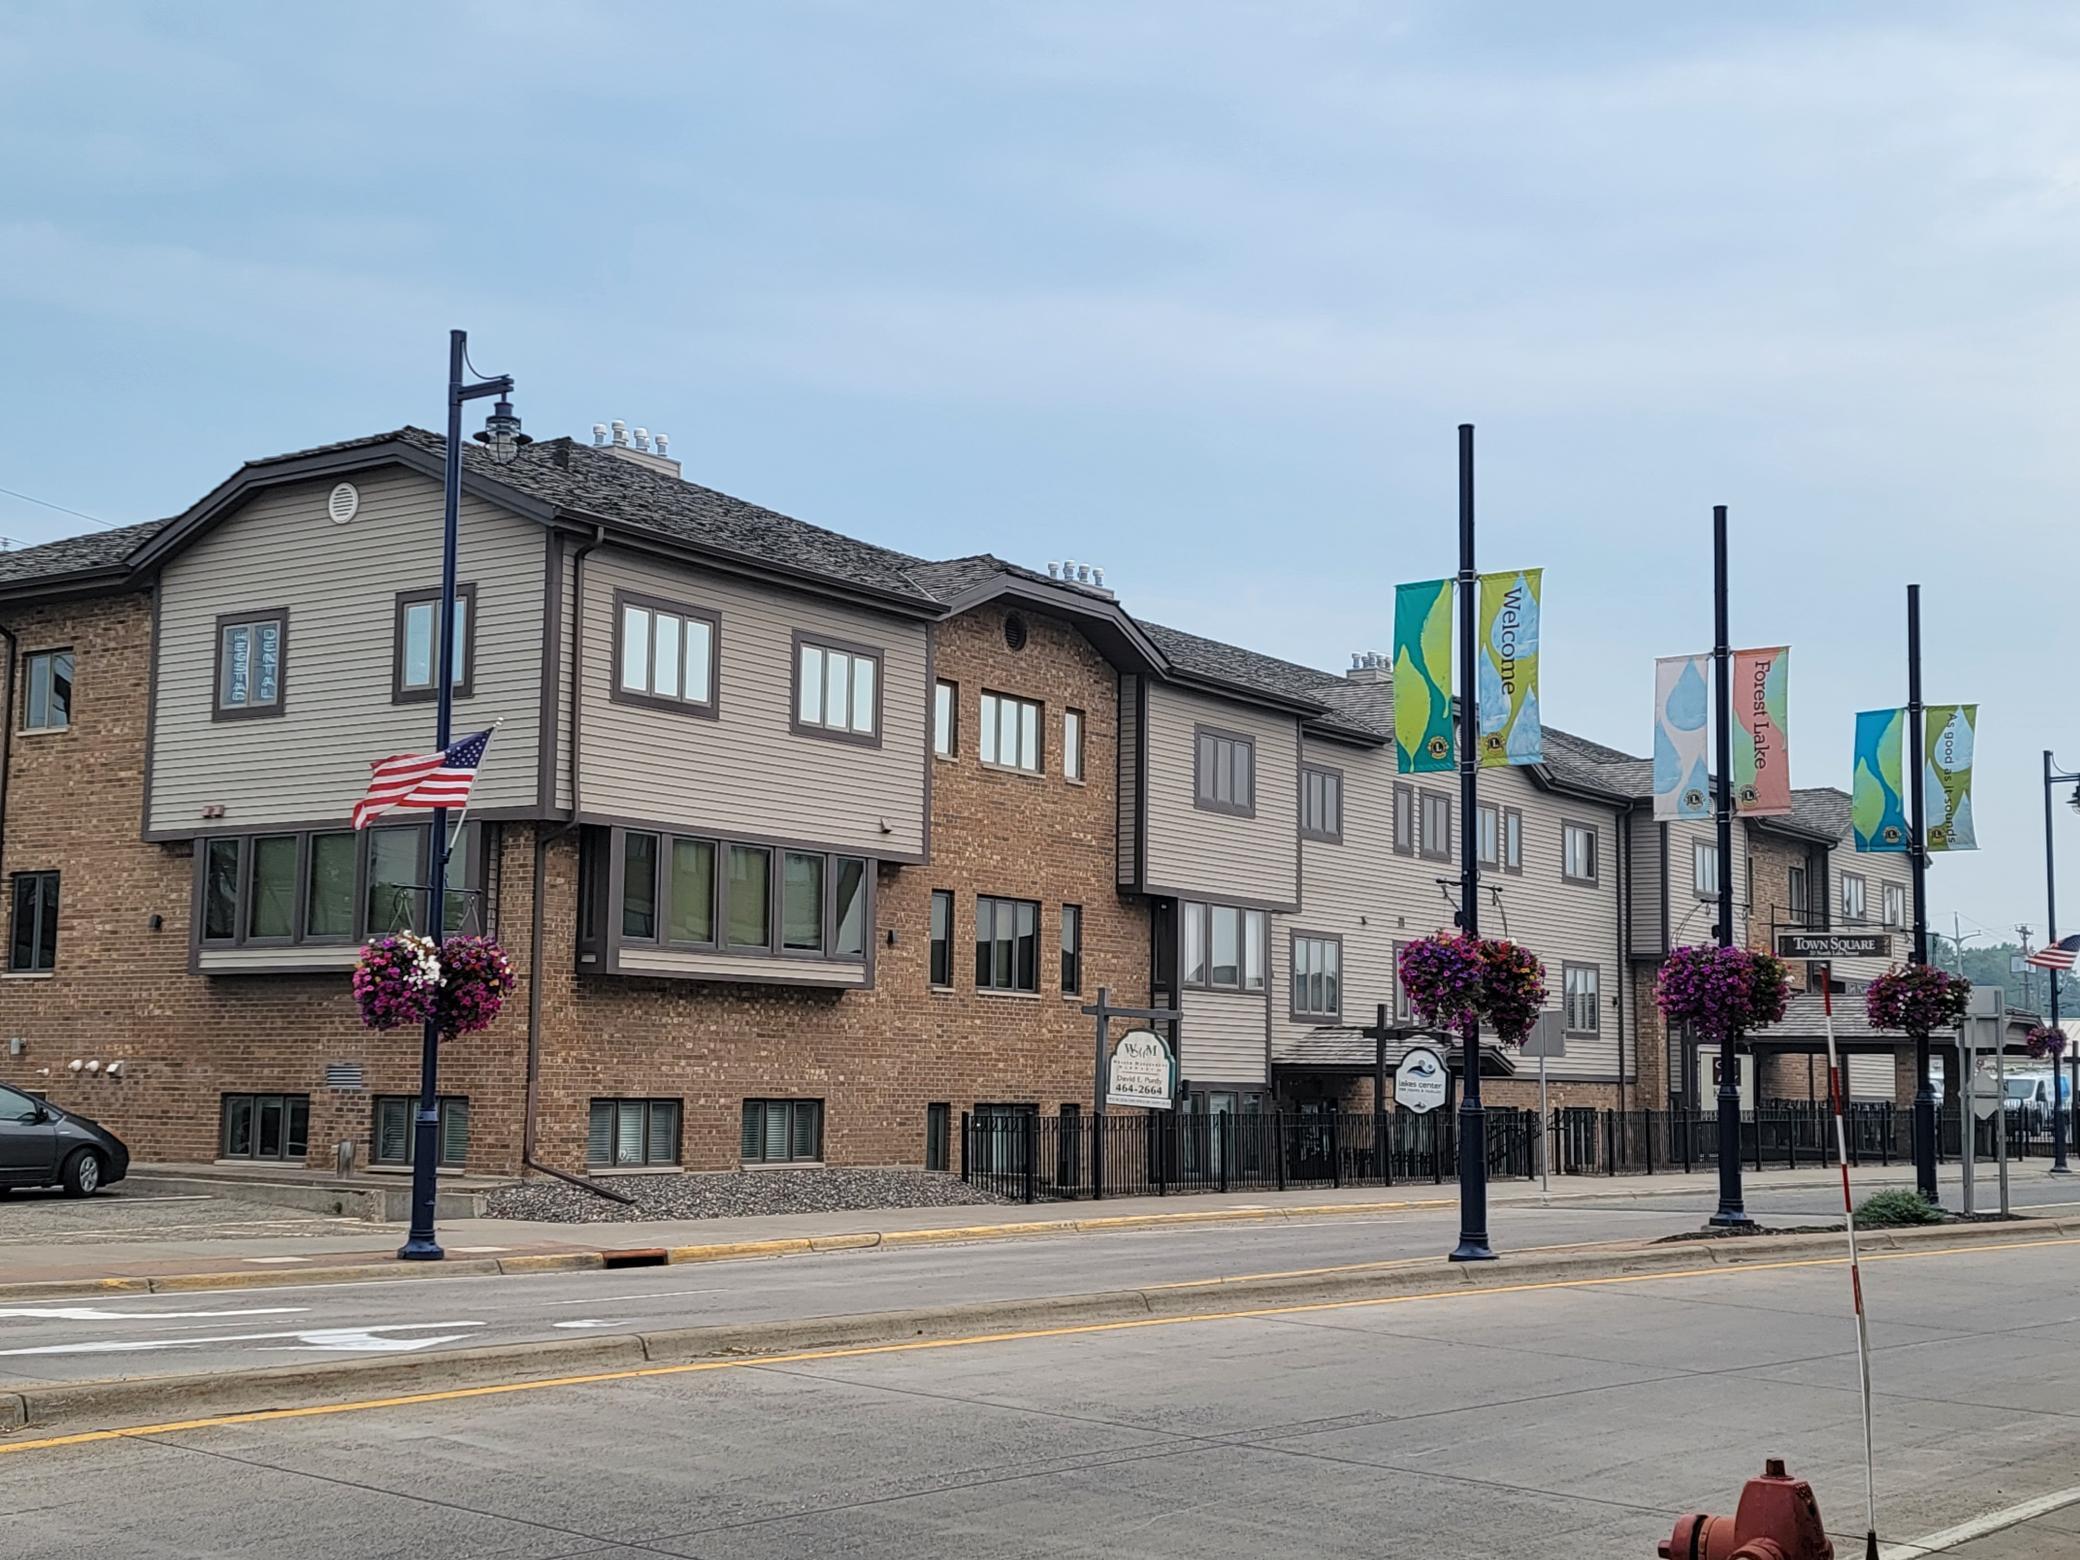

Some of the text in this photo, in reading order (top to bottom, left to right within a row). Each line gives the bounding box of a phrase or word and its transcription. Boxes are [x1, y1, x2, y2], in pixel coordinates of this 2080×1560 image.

[1501, 587, 1522, 695] Welcome
[260, 628, 277, 699] DENTAL
[1753, 660, 1771, 769] Forest Lake
[1946, 713, 1958, 728] As
[1944, 731, 1954, 764] good
[1944, 768, 1952, 782] as
[1944, 798, 1958, 843] sounds
[1793, 937, 1829, 950] TOWN
[1830, 936, 1876, 952] SQUARE
[1115, 1084, 1162, 1095] 464-2664
[1116, 1075, 1136, 1083] David
